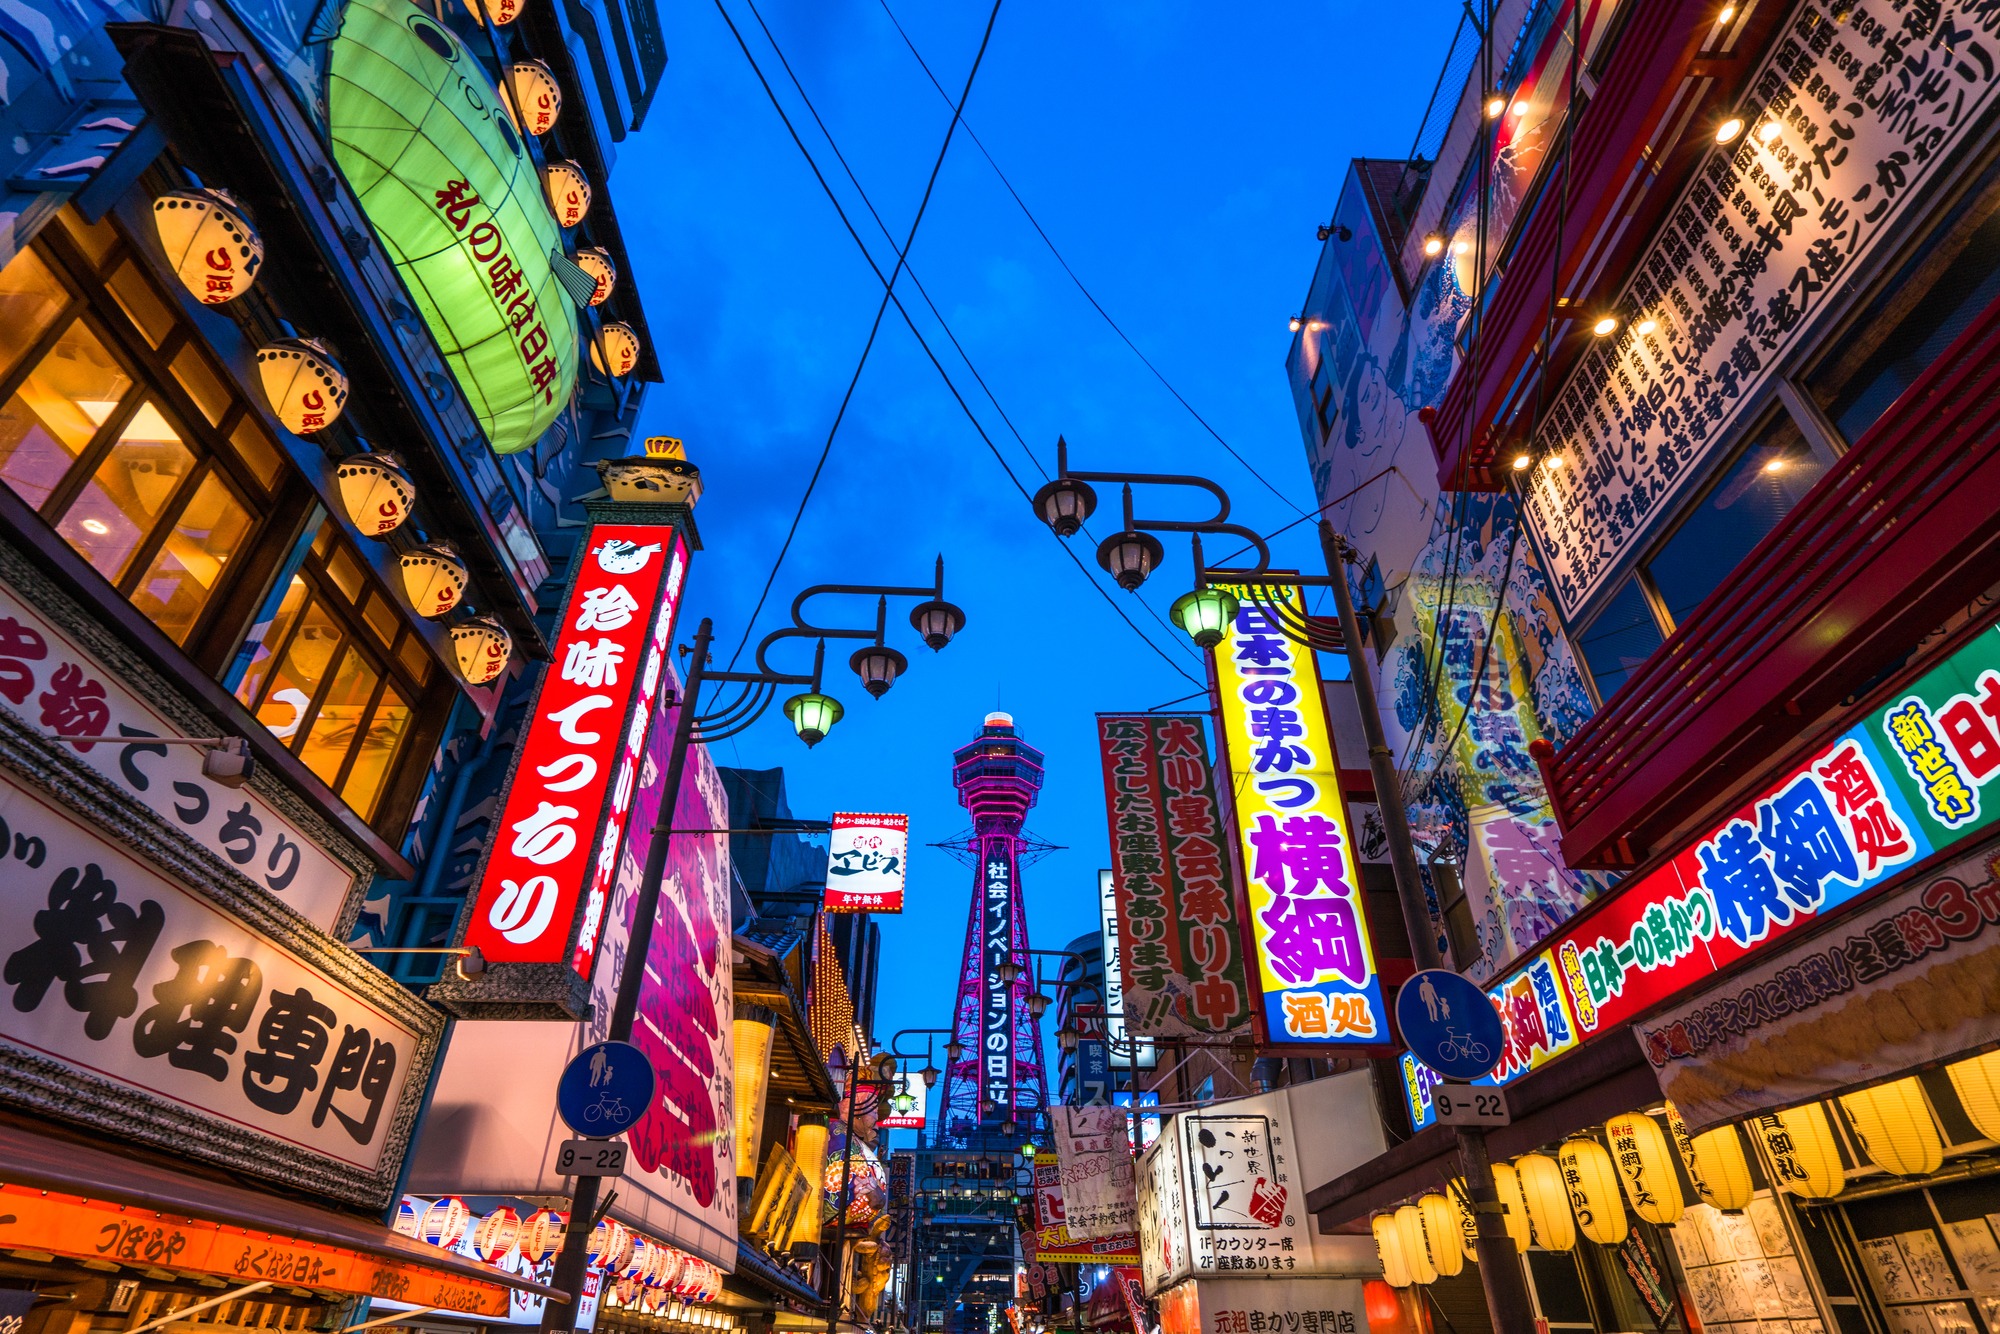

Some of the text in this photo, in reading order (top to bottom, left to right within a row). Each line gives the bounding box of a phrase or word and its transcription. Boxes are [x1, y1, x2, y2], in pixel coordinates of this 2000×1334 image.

[1826, 36, 1865, 84] 山の幸
[1848, 2, 1889, 51] 山の幸
[1878, 28, 1966, 125] ホルモン
[1806, 124, 1892, 233] たこ
[1828, 92, 1919, 202] いか
[1767, 180, 1847, 288] 貝柱
[1786, 155, 1868, 261] サーモン
[435, 177, 558, 406] 私の味は日本一
[1715, 263, 1783, 363] かぼちゃ
[1731, 235, 1804, 340] 海老
[1669, 331, 1729, 427] じゃが芋
[1683, 308, 1746, 406] 茄子
[1699, 286, 1764, 385] 椎茸
[1628, 391, 1683, 485] 銀杏
[1641, 372, 1697, 466] 白ねぎ
[1655, 353, 1712, 447] さつま芋
[1592, 445, 1640, 535] 山芋
[1604, 429, 1653, 519] しし唐
[1616, 411, 1667, 501] れんこん
[1560, 494, 1603, 579] 紅しょうが
[1570, 481, 1614, 565] にんにく
[1581, 462, 1627, 550] 玉ねぎ
[1540, 525, 1580, 607] もち
[1550, 509, 1592, 593] うずら玉子
[1235, 604, 1317, 811] 日本一の串かつ
[488, 584, 640, 945] 珍味てっちり
[1889, 701, 1974, 822] 新世界
[1818, 744, 1909, 872] 酒処
[841, 894, 883, 905] 年中無休
[1155, 718, 1241, 1033] 大小宴会承り中
[1249, 814, 1368, 986] 横綱
[1698, 776, 1860, 945] 横綱
[986, 861, 1010, 1106] 社会イノベーションの日立
[1561, 943, 1596, 1028] 新世界
[1582, 892, 1713, 1004] 日本一の串かつ
[1283, 992, 1374, 1037] 酒処
[1530, 961, 1571, 1048] 酒処
[1088, 1043, 1104, 1076] 喫茶
[1439, 1094, 1504, 1117] 9-22
[1611, 1124, 1634, 1138] 秘伝
[562, 1149, 622, 1169] 9-22
[1060, 1155, 1111, 1187] 大阪名物
[1241, 1129, 1265, 1176] 新世界
[1616, 1137, 1658, 1207] 横綱ソース
[443, 1205, 459, 1238] アサヒビール
[482, 1217, 500, 1249] アサヒビール
[533, 1219, 550, 1252] アサヒビール
[1067, 1207, 1137, 1229] 宴会予約受付中
[1565, 1168, 1594, 1226] 串かつ
[95, 1219, 188, 1266] づぼらや
[233, 1244, 338, 1284] ふぐなら日本一
[1200, 1236, 1294, 1252] 1F カウンター席
[1200, 1255, 1297, 1271] 2F 座敷あります
[1213, 1309, 1356, 1334] 元祖串カツ専門店
